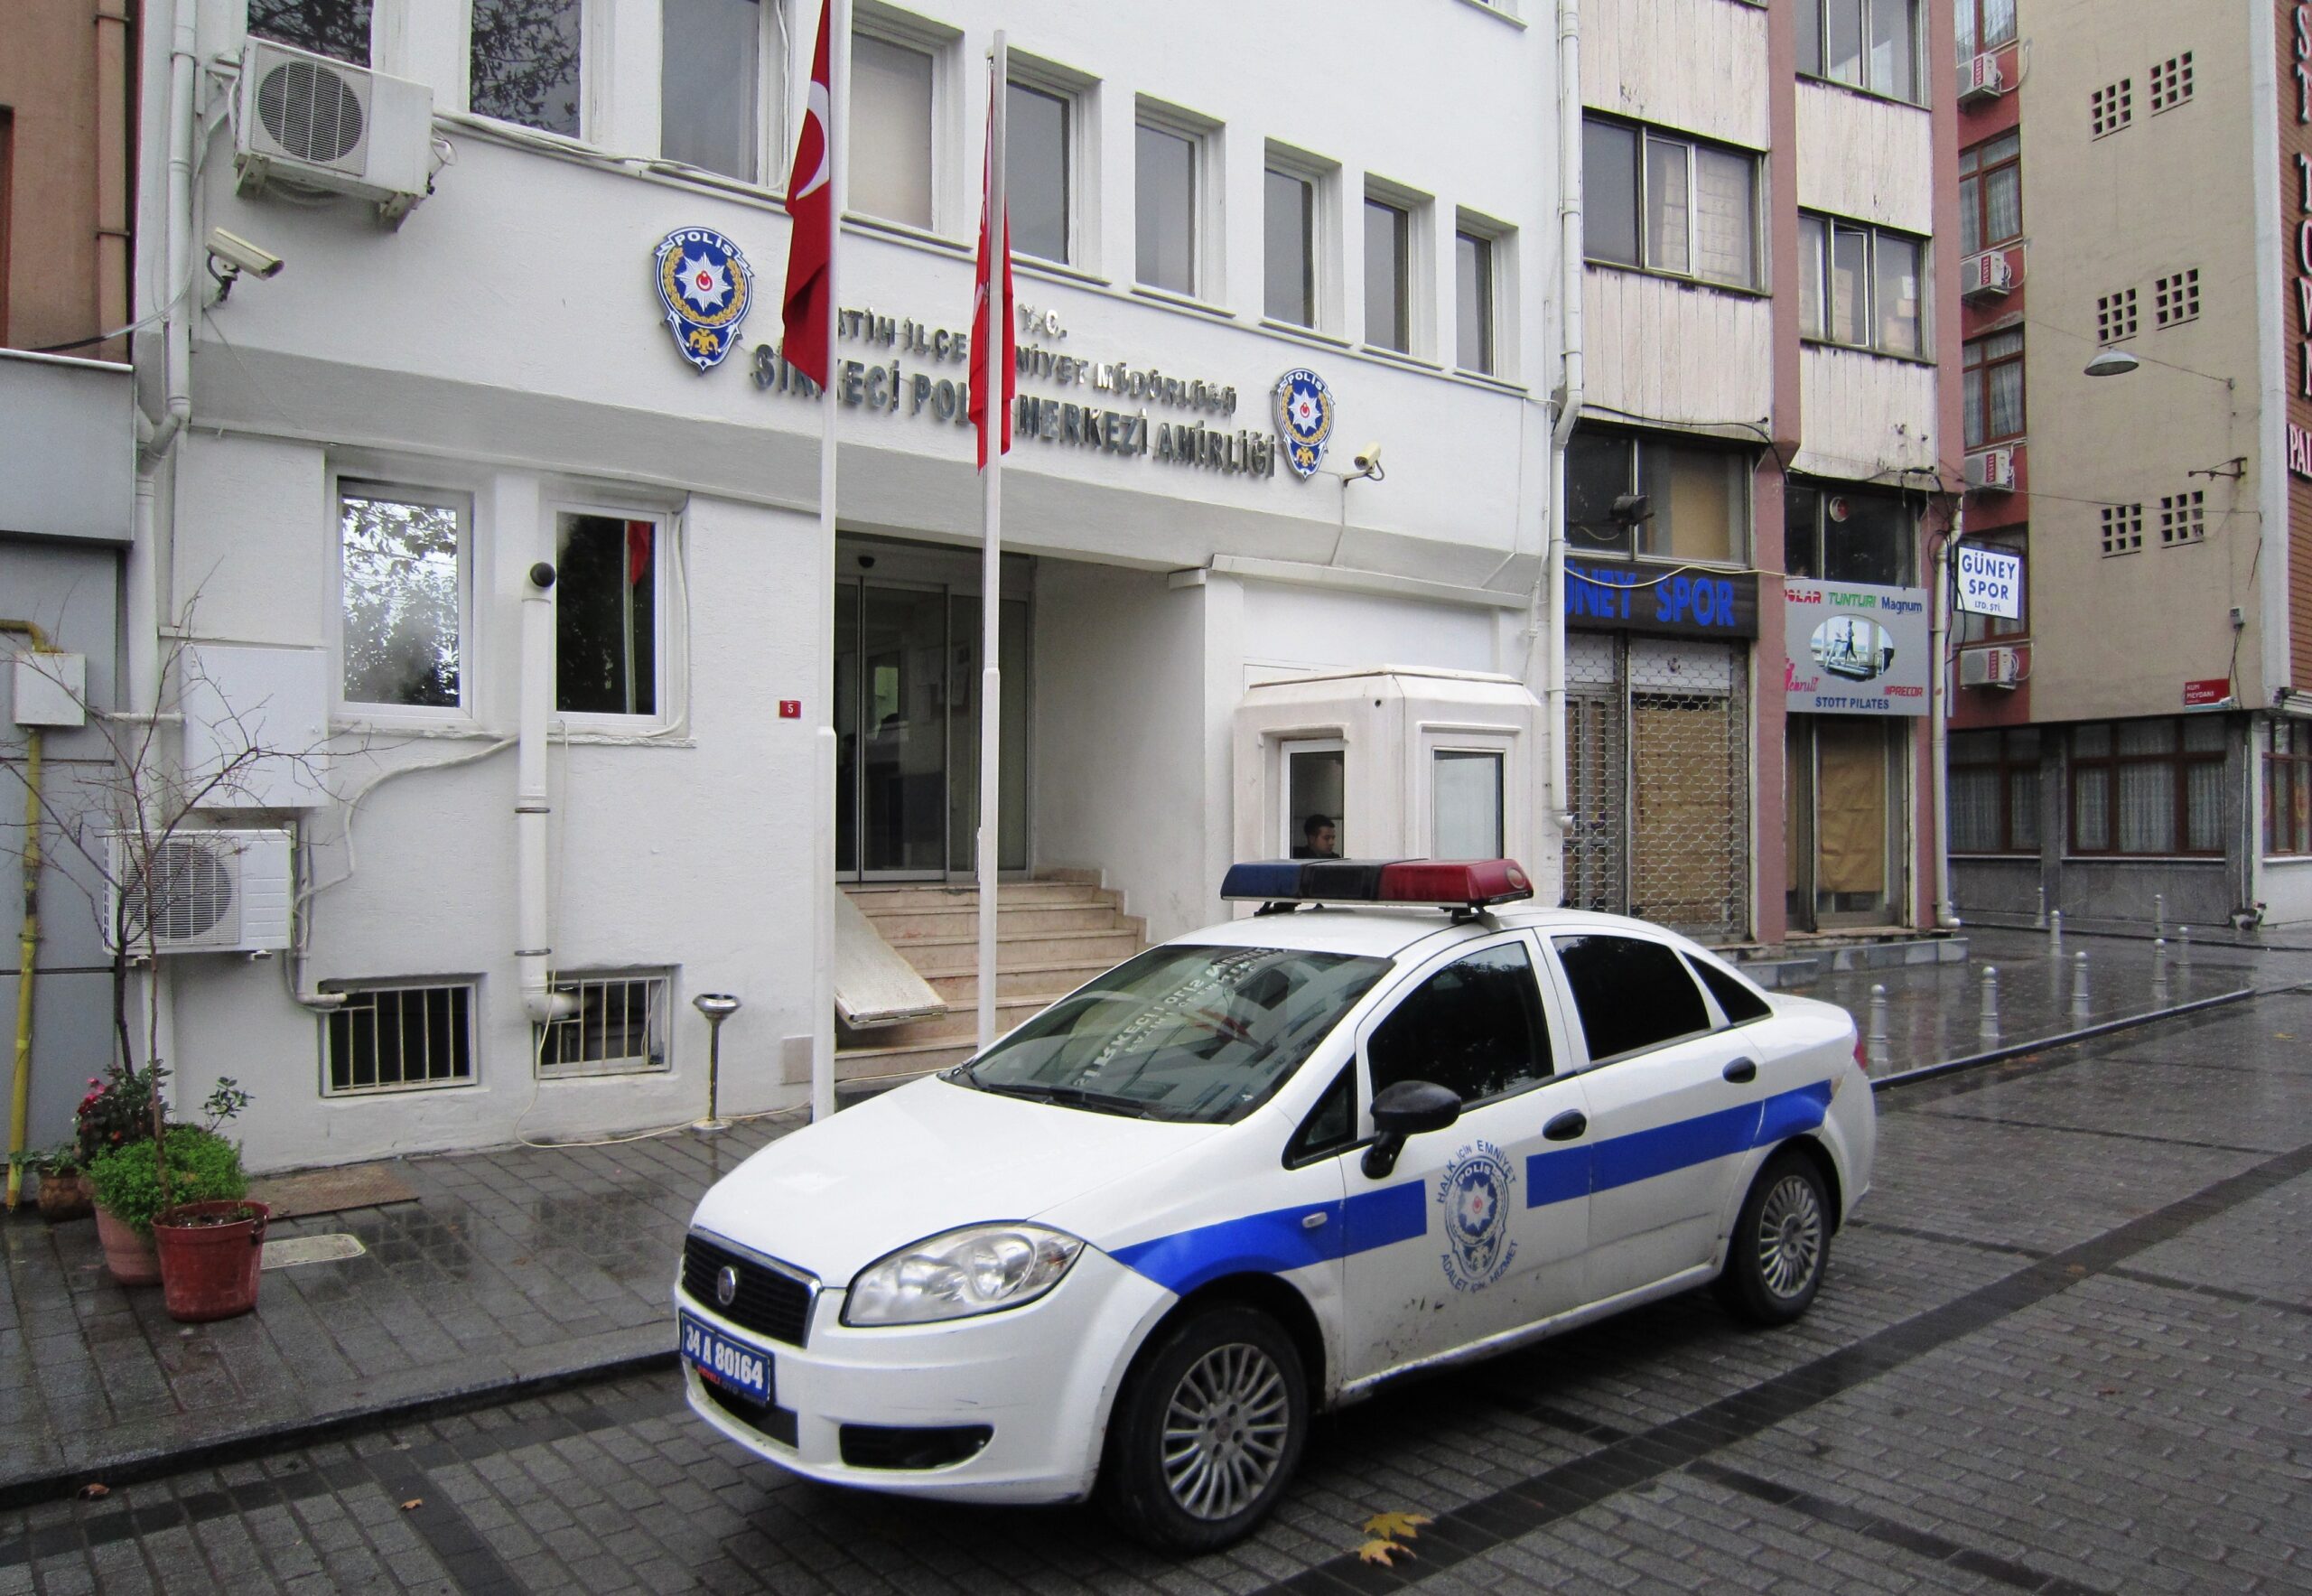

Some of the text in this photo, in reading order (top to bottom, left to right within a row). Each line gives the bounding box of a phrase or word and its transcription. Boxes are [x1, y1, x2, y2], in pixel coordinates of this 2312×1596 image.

[1974, 58, 1982, 87] VESTEL
[903, 317, 967, 362] İLÇE
[911, 373, 971, 426] POL
[1014, 394, 1148, 455] MERKEZİ
[1152, 419, 1275, 479] AMİRLİĞİ
[1962, 552, 2017, 581] GÜNEY
[1655, 574, 1736, 627] SPOR
[1968, 578, 2009, 601] SPOR
[1881, 596, 1923, 615] Magnum
[1815, 696, 1890, 711] STOTT PILATES
[1888, 685, 1924, 697] PRECOR
[788, 704, 794, 714] 5
[1437, 1160, 1456, 1204] HALK
[1477, 1139, 1517, 1185] EMNİYET
[1440, 1254, 1468, 1293] ADALET
[685, 1324, 701, 1358] 34
[702, 1336, 713, 1366] A
[714, 1341, 764, 1390] 80164
